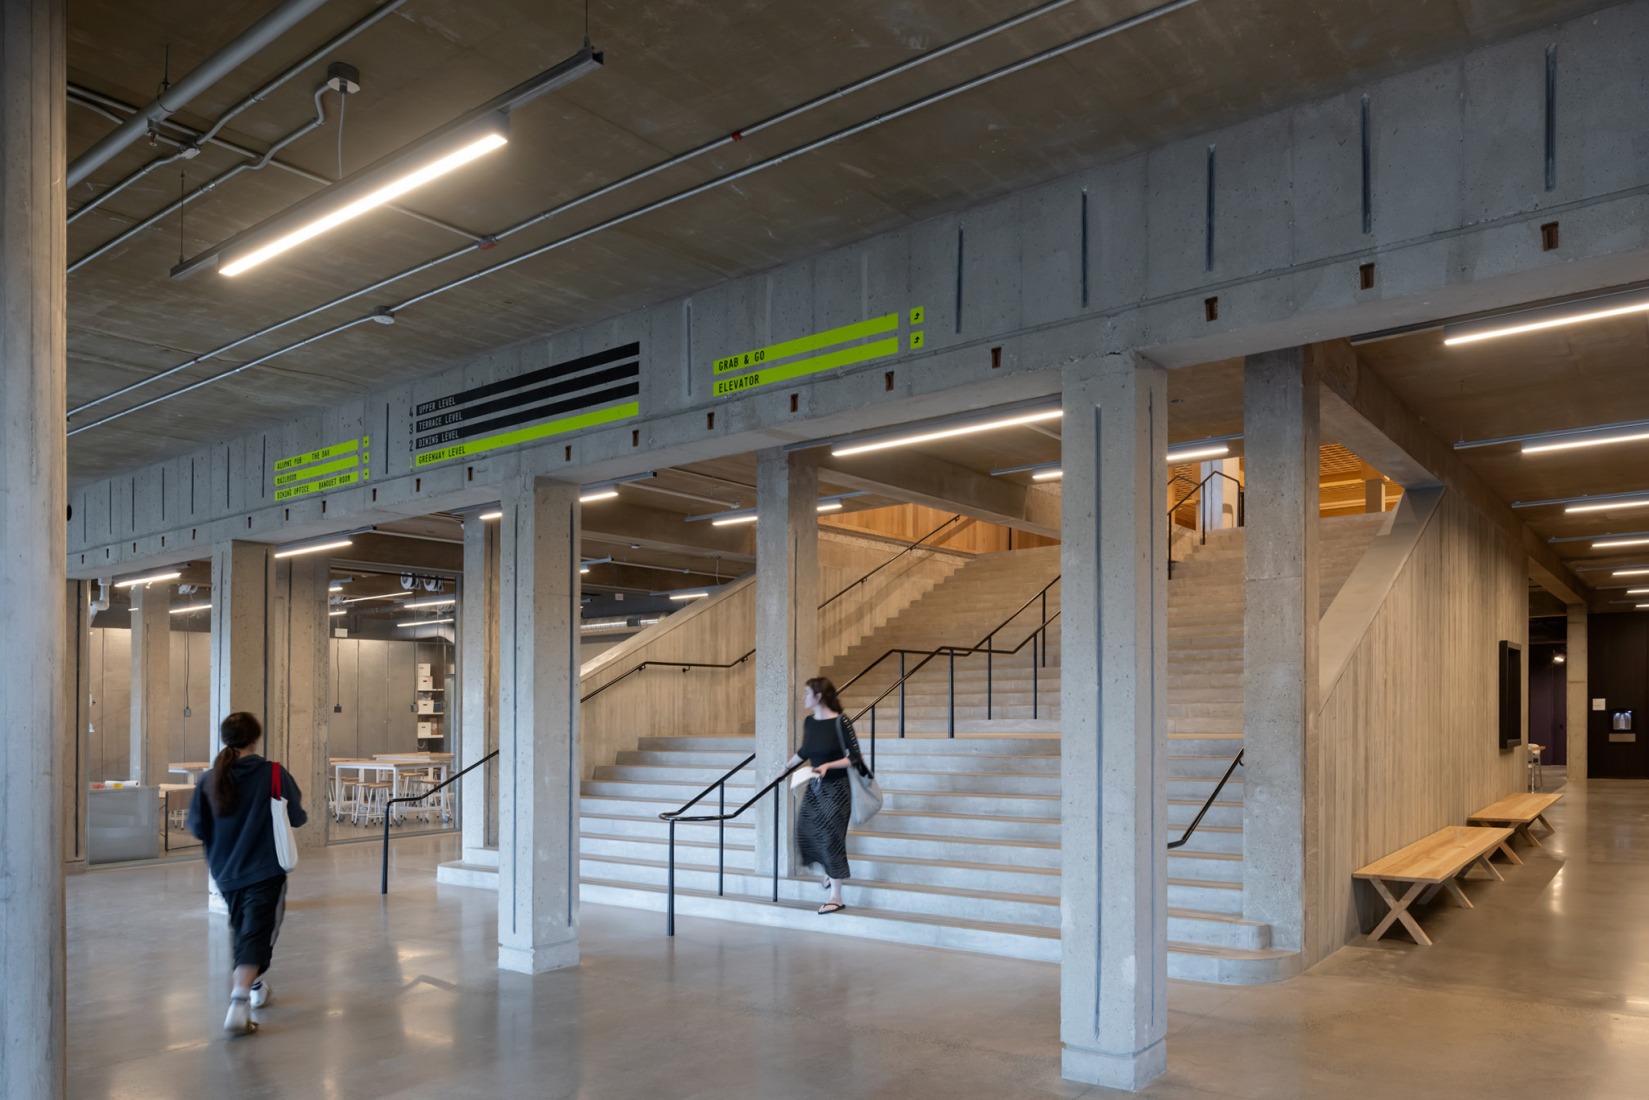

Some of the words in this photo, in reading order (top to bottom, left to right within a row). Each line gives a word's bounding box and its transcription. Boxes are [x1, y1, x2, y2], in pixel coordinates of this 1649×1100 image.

[719, 357, 739, 371] GRAB
[744, 354, 749, 364] &
[755, 349, 764, 361] GO
[719, 374, 759, 393] ELEVATOR
[409, 407, 413, 417] 4
[419, 402, 436, 414] UPPER
[439, 397, 456, 408] LEVEL
[419, 417, 442, 430] TERRACE
[445, 411, 462, 423] LEVEL
[409, 424, 413, 434] 3
[409, 441, 413, 451] 2
[419, 436, 438, 447] DINING
[442, 430, 459, 441] LEVEL
[419, 450, 445, 464] GREENWAY
[448, 446, 465, 457] LEVEL
[277, 474, 297, 484] MAILROOM
[319, 478, 336, 489] BANQUET
[339, 475, 350, 484] ROOM
[294, 485, 309, 495] OFFICE
